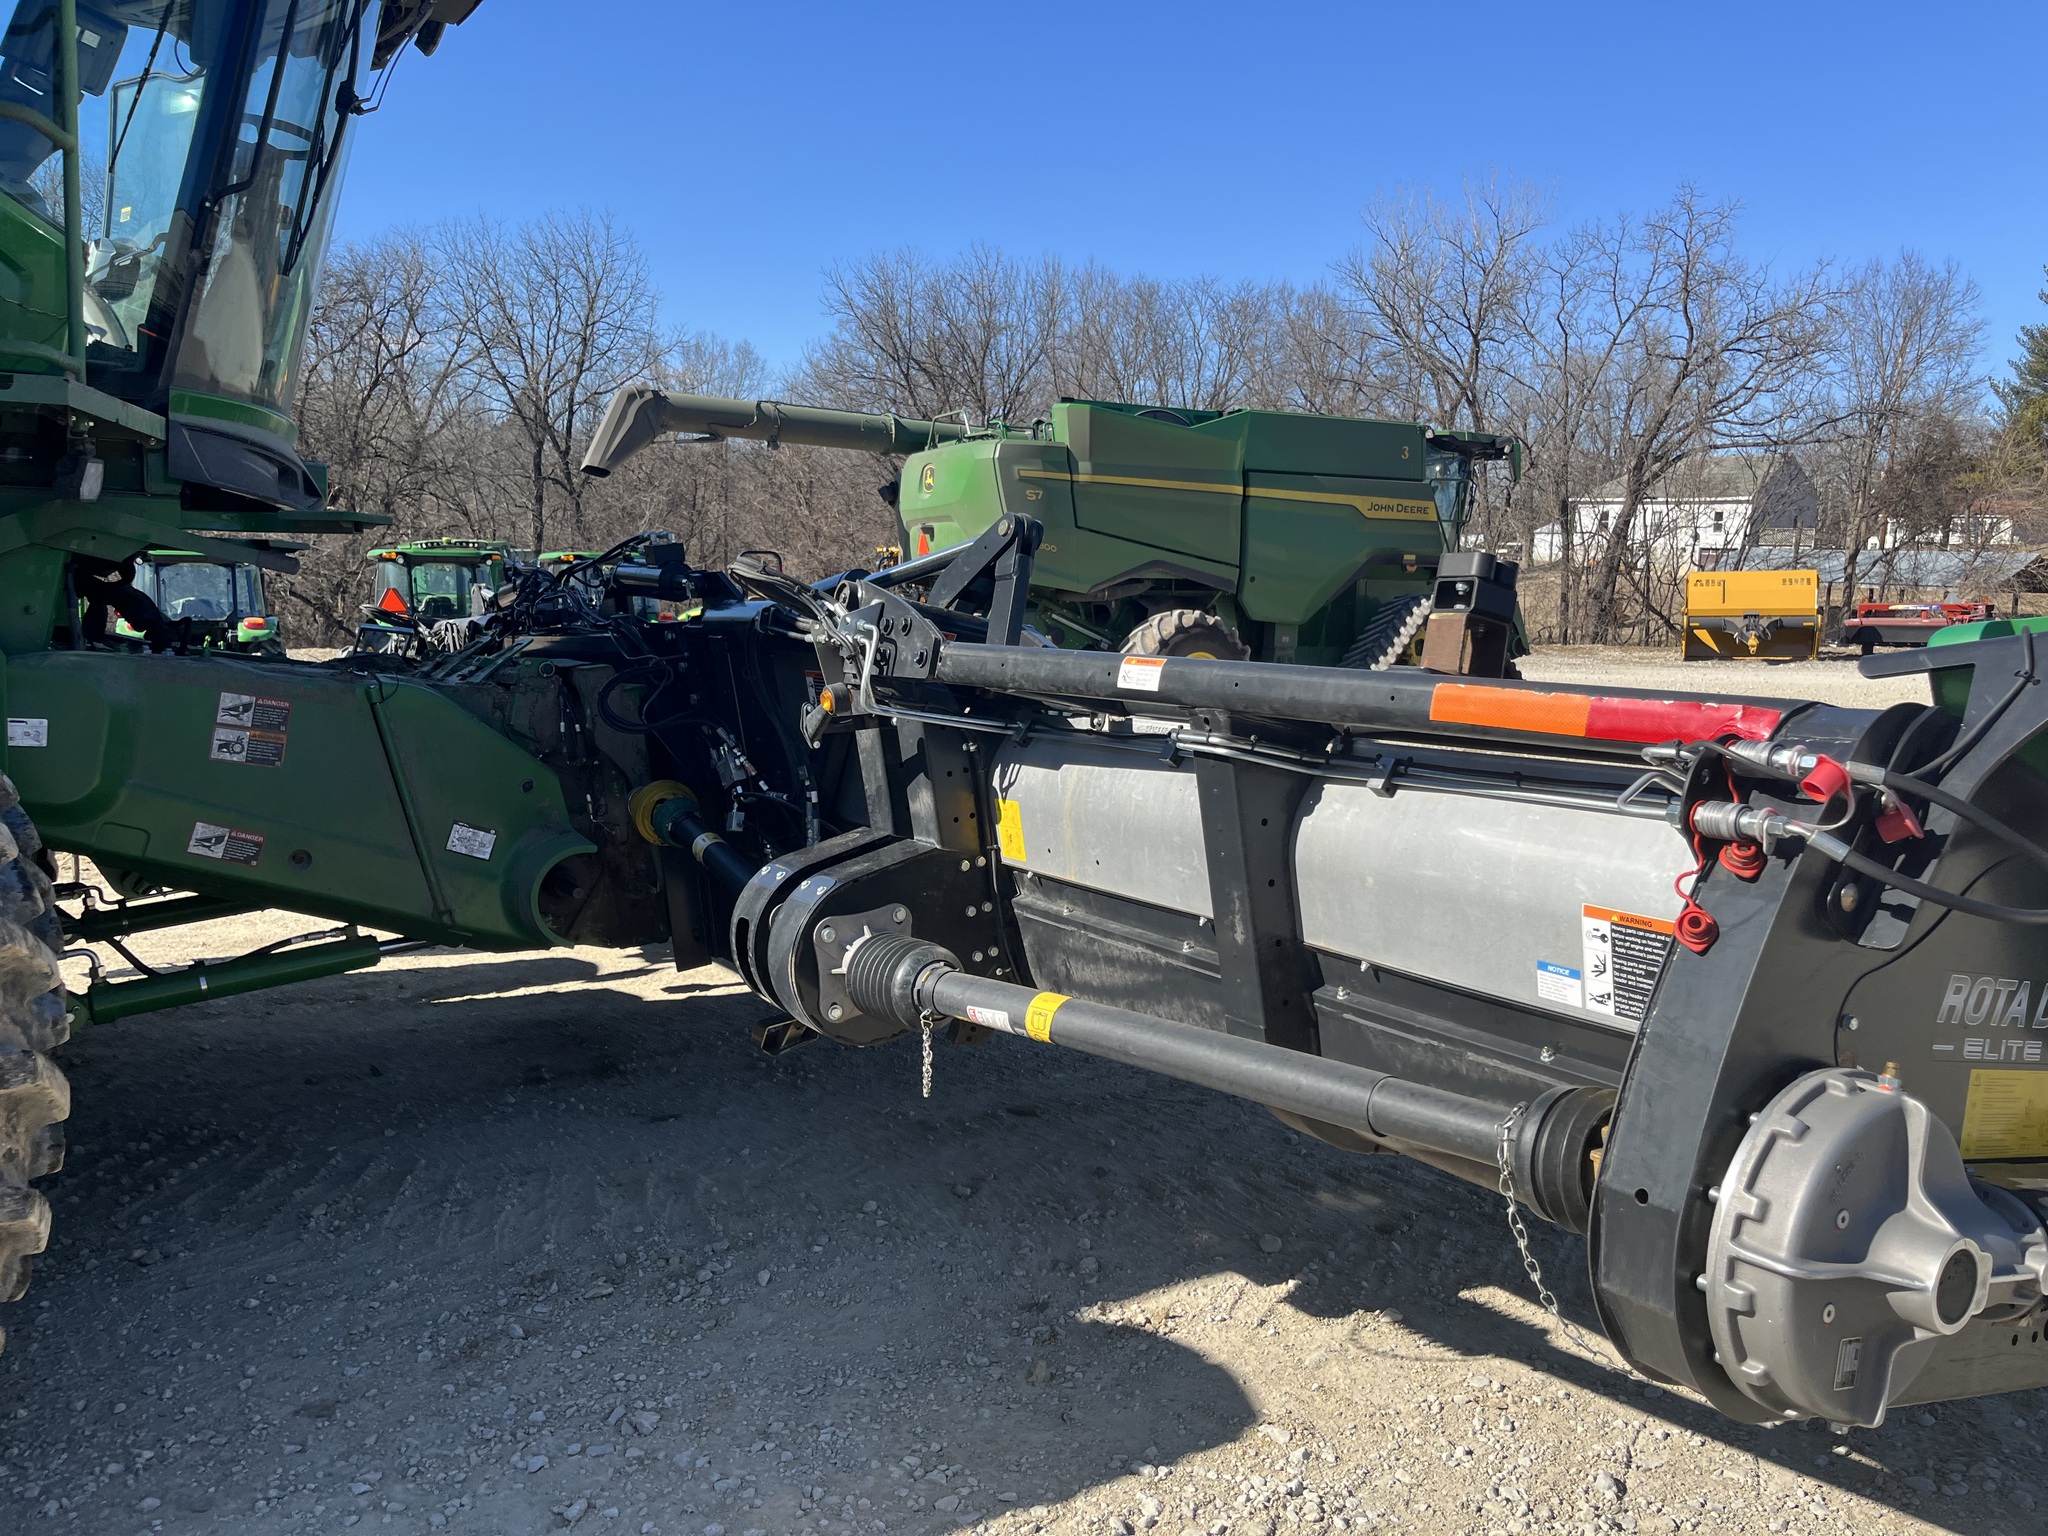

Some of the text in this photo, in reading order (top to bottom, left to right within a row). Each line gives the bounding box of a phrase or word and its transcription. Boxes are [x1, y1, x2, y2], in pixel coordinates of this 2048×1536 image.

[1401, 446, 1409, 459] 3
[1025, 489, 1043, 501] S7
[1367, 502, 1429, 515] JOHN DEERE
[263, 699, 290, 708] DANGER
[236, 831, 264, 842] DANGER
[1619, 915, 1653, 928] WARNING
[1611, 924, 1626, 933] Moving
[1625, 936, 1641, 944] working
[1647, 940, 1663, 948] header:
[1615, 946, 1626, 954] Apply
[1646, 953, 1663, 962] parking
[1613, 957, 1627, 965] Moving
[1547, 965, 1570, 976] NOTICE
[1613, 976, 1628, 984] header
[1636, 976, 1654, 985] between
[1614, 988, 1629, 998] Sinking
[1629, 992, 1643, 1000] header
[1614, 996, 1644, 1009] Before working
[1936, 974, 2031, 1028] ROTA
[1615, 1002, 1643, 1014] engage safety
[1963, 1038, 2042, 1061] ELITE
